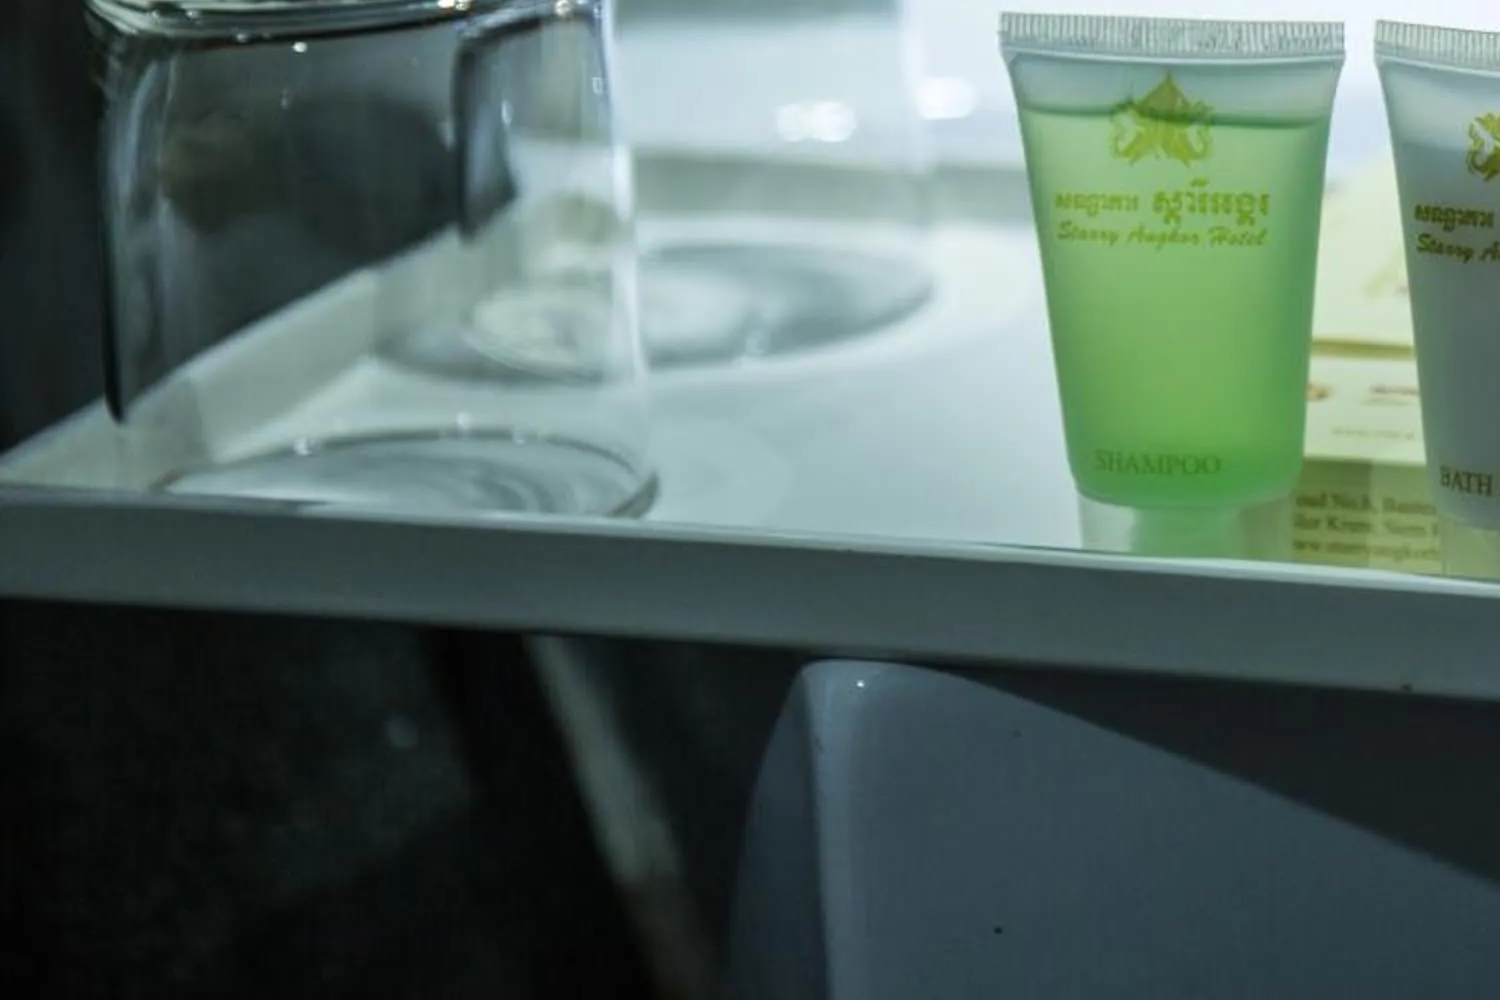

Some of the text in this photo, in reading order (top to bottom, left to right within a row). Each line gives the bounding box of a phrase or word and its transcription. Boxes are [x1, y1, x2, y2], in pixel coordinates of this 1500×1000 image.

[1207, 225, 1270, 247] Hotel
[1094, 450, 1222, 476] SHAMPOO
[1439, 465, 1494, 497] BATH
